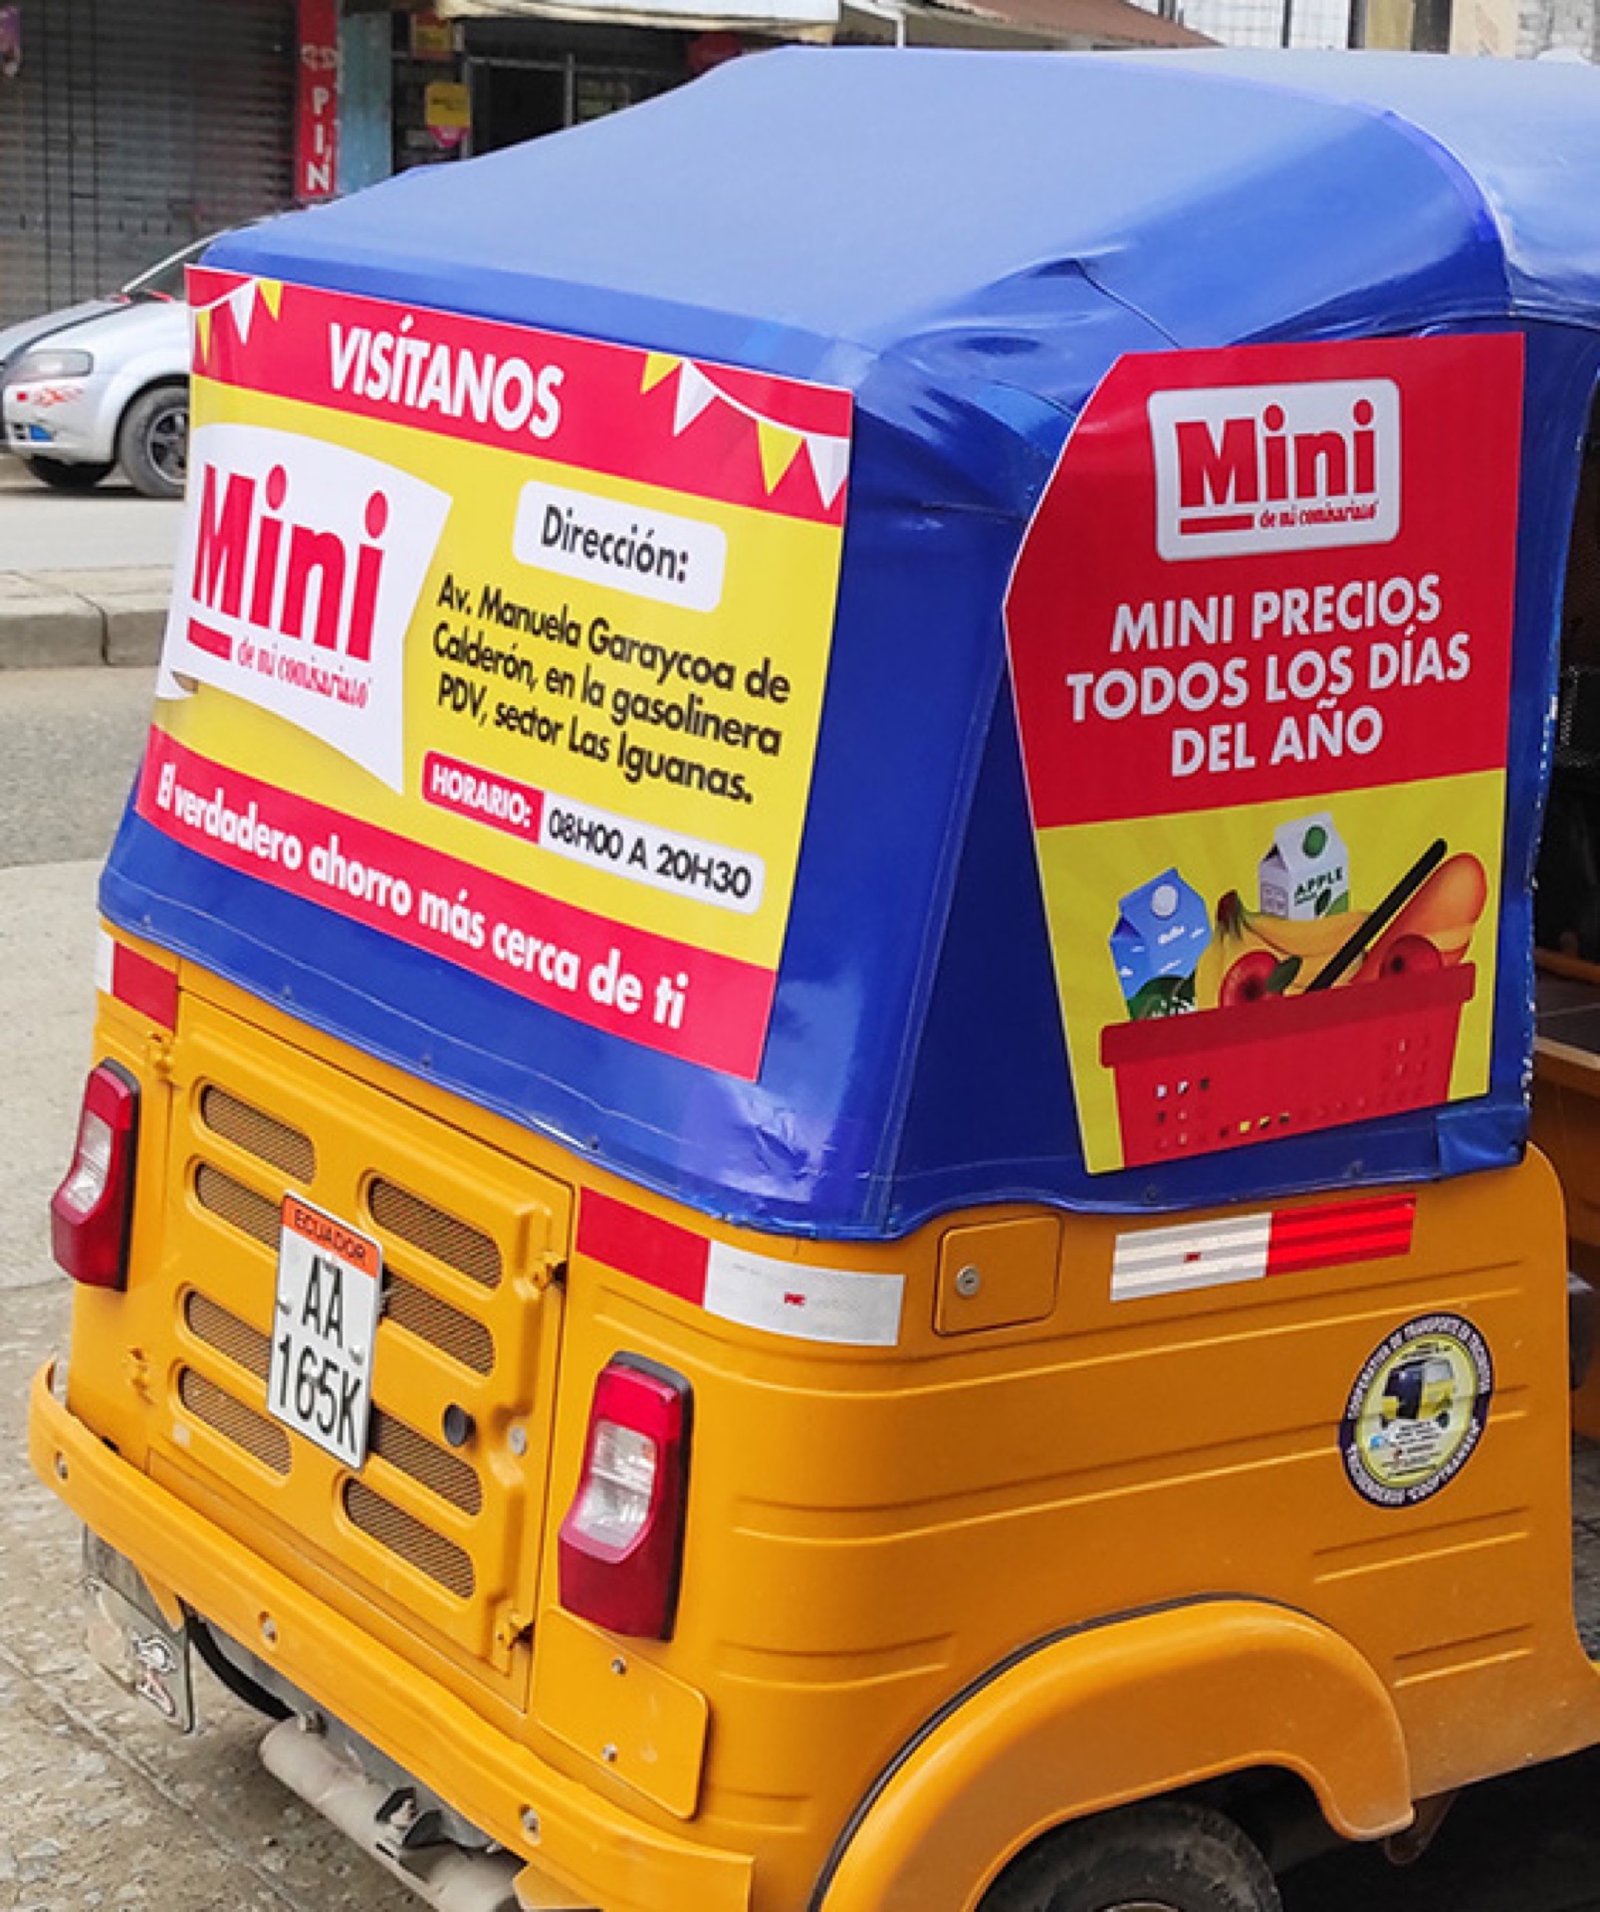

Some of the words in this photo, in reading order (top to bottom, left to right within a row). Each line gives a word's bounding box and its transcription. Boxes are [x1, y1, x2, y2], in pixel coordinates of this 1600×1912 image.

[329, 315, 564, 440] VISÍTANOS
[1175, 398, 1377, 508] Mini
[191, 462, 389, 662] Mini
[540, 505, 690, 584] Dirección:
[436, 573, 472, 615] Av.
[477, 584, 581, 648] Manuela
[588, 617, 735, 691] Garaycoa
[744, 656, 791, 703] de
[1109, 594, 1235, 653] MINI
[1251, 572, 1442, 641] PRECIOS
[433, 622, 538, 690] Calderón,
[545, 665, 575, 699] en
[582, 664, 606, 708] la
[611, 690, 782, 756] gasolinera
[1066, 658, 1249, 723] TODOS
[1265, 646, 1354, 703] LOS
[1369, 624, 1471, 691] DÍAS
[437, 672, 488, 728] PDV,
[494, 698, 564, 746] sector
[568, 715, 610, 762] Las
[617, 731, 753, 805] Iguanas.
[1171, 722, 1256, 777] DEL
[1269, 696, 1383, 766] AÑO
[430, 763, 533, 828] HORARIO:
[548, 807, 624, 861] 08H00
[627, 837, 649, 870] A
[656, 844, 752, 899] 20H30
[1294, 866, 1343, 899] APPLE
[156, 762, 174, 811] El
[173, 782, 303, 872] verdadero
[309, 834, 413, 917] ahorro
[418, 888, 487, 950] más
[492, 922, 579, 990] cerca
[588, 948, 643, 1014] de
[653, 972, 689, 1029] ti
[293, 1207, 367, 1261] ECUADOR
[302, 1254, 343, 1349] AA
[278, 1333, 362, 1455] 165K
